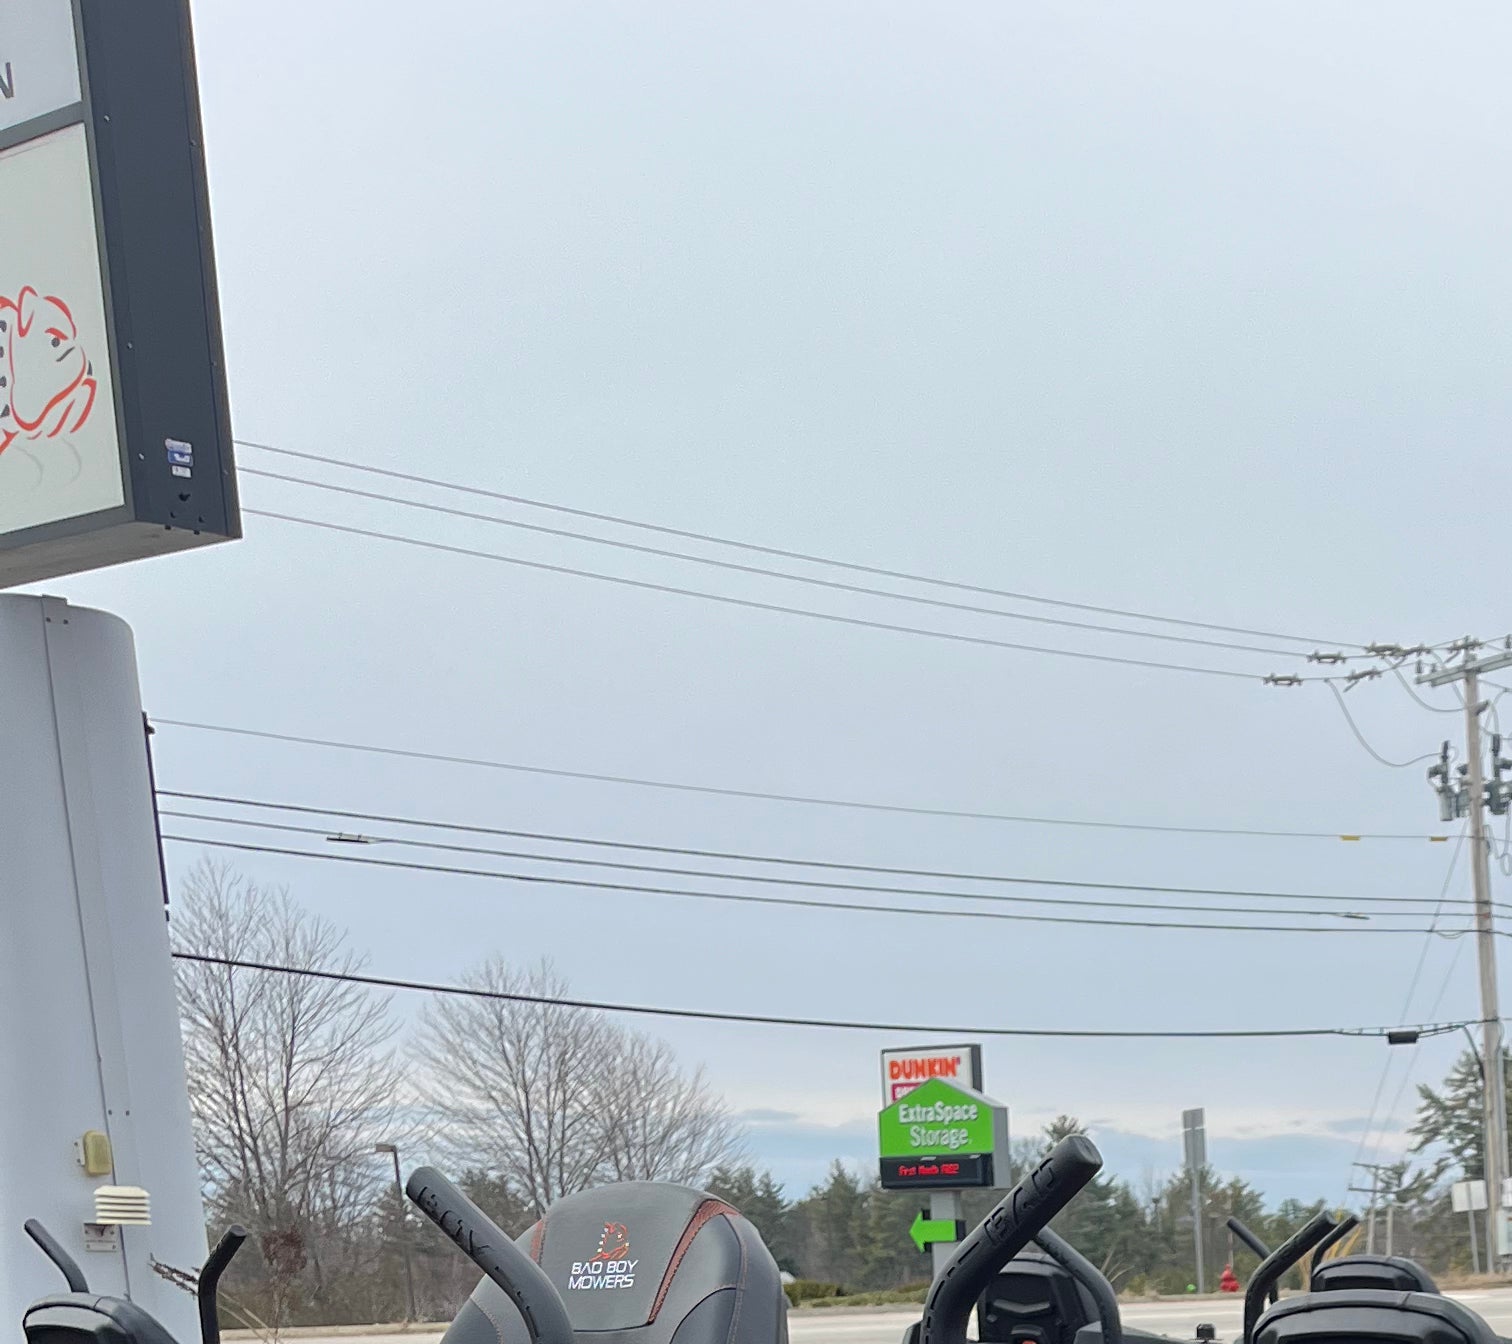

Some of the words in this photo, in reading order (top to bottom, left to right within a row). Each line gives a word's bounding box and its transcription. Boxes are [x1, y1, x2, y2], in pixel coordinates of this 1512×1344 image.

[889, 1056, 961, 1080] DUNKIN'
[909, 1124, 969, 1150] Storage
[571, 1261, 603, 1275] BAD
[606, 1259, 639, 1274] BOY
[568, 1273, 636, 1290] MOWERS
